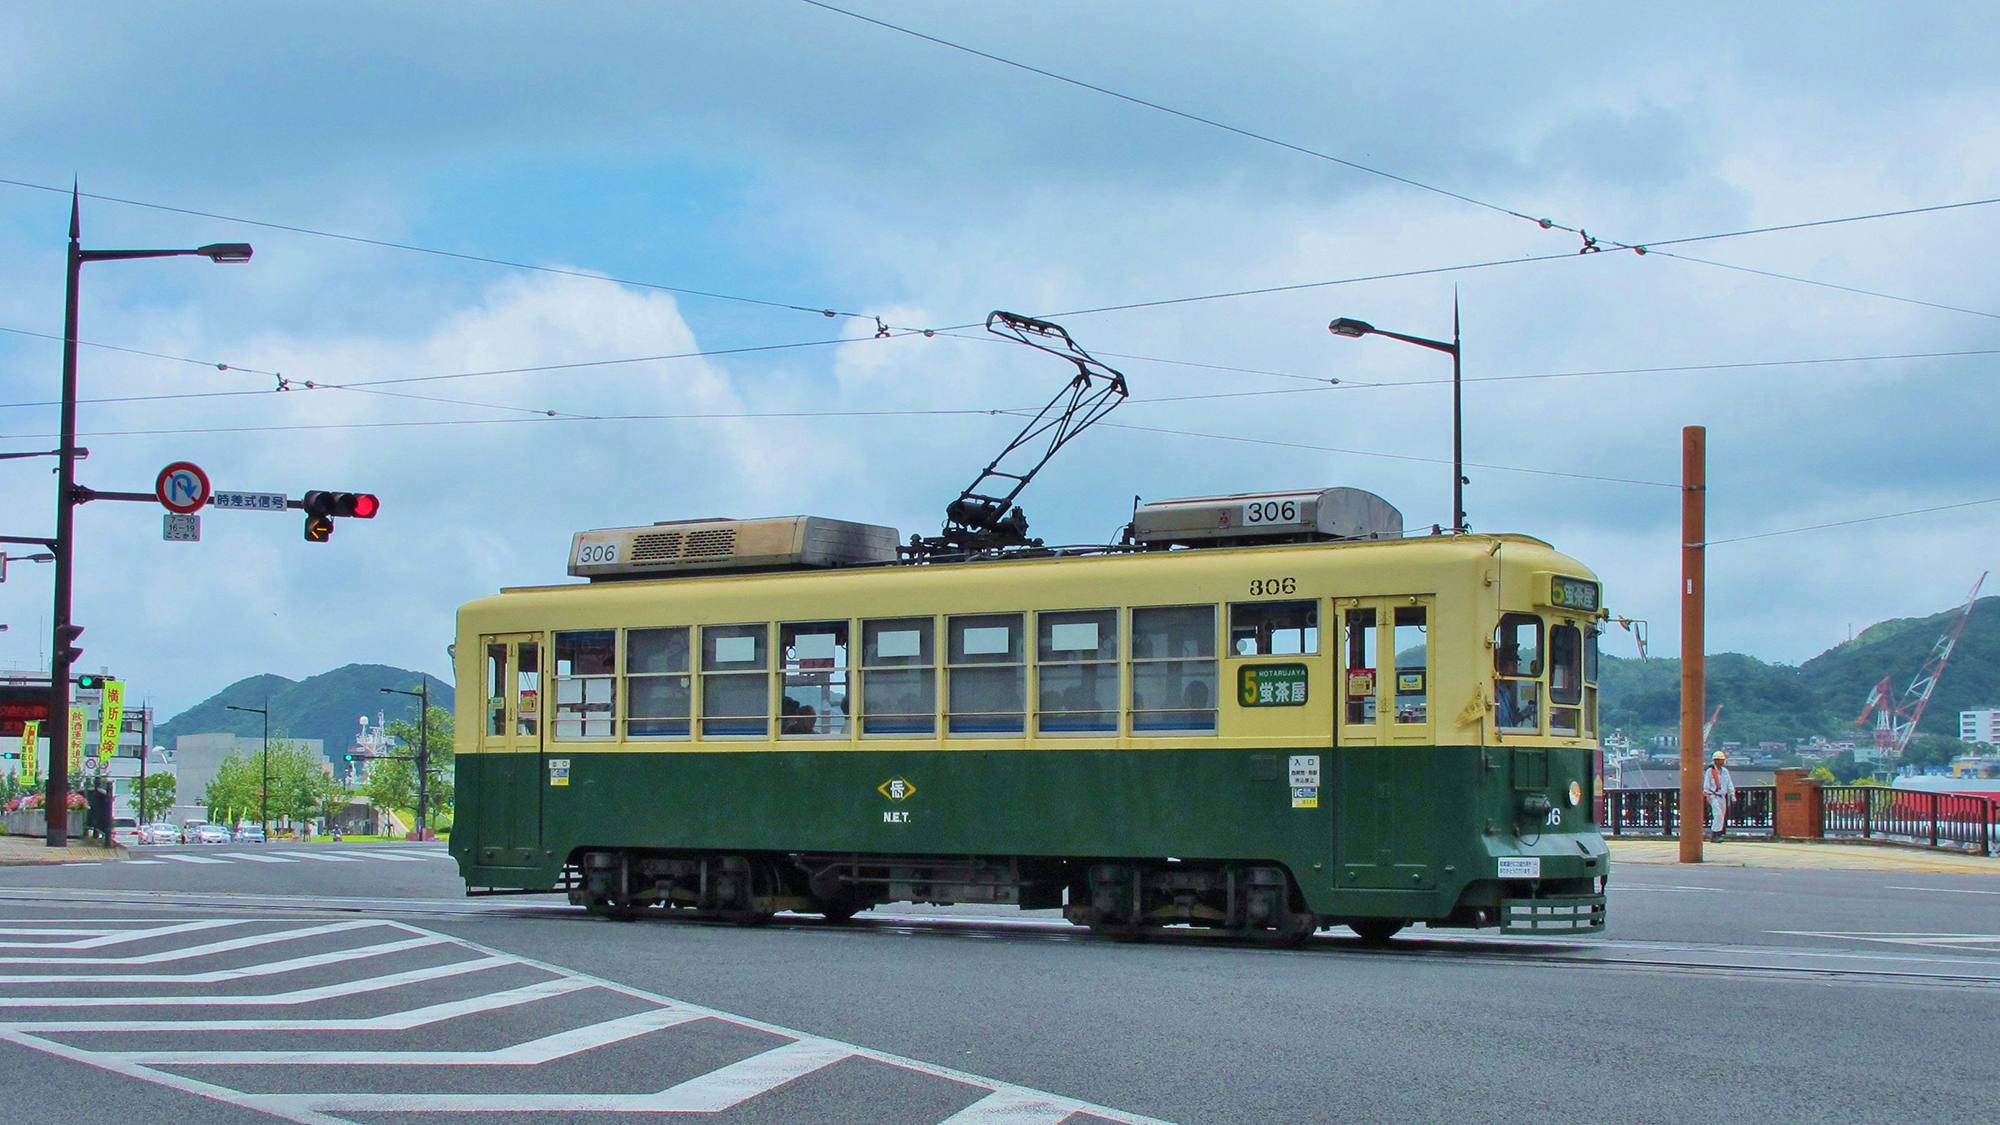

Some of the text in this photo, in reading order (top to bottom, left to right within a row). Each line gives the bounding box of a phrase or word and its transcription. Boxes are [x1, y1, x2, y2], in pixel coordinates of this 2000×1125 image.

[217, 495, 285, 509] 時差式信号
[1248, 500, 1296, 522] 306
[581, 545, 616, 562] 306
[1249, 577, 1296, 596] 306
[1553, 580, 1565, 604] 5
[1259, 669, 1306, 677] HOTARUJAYA
[1245, 671, 1257, 703] 5
[102, 688, 119, 754] 横断危険
[883, 811, 912, 823] N.E.T.
